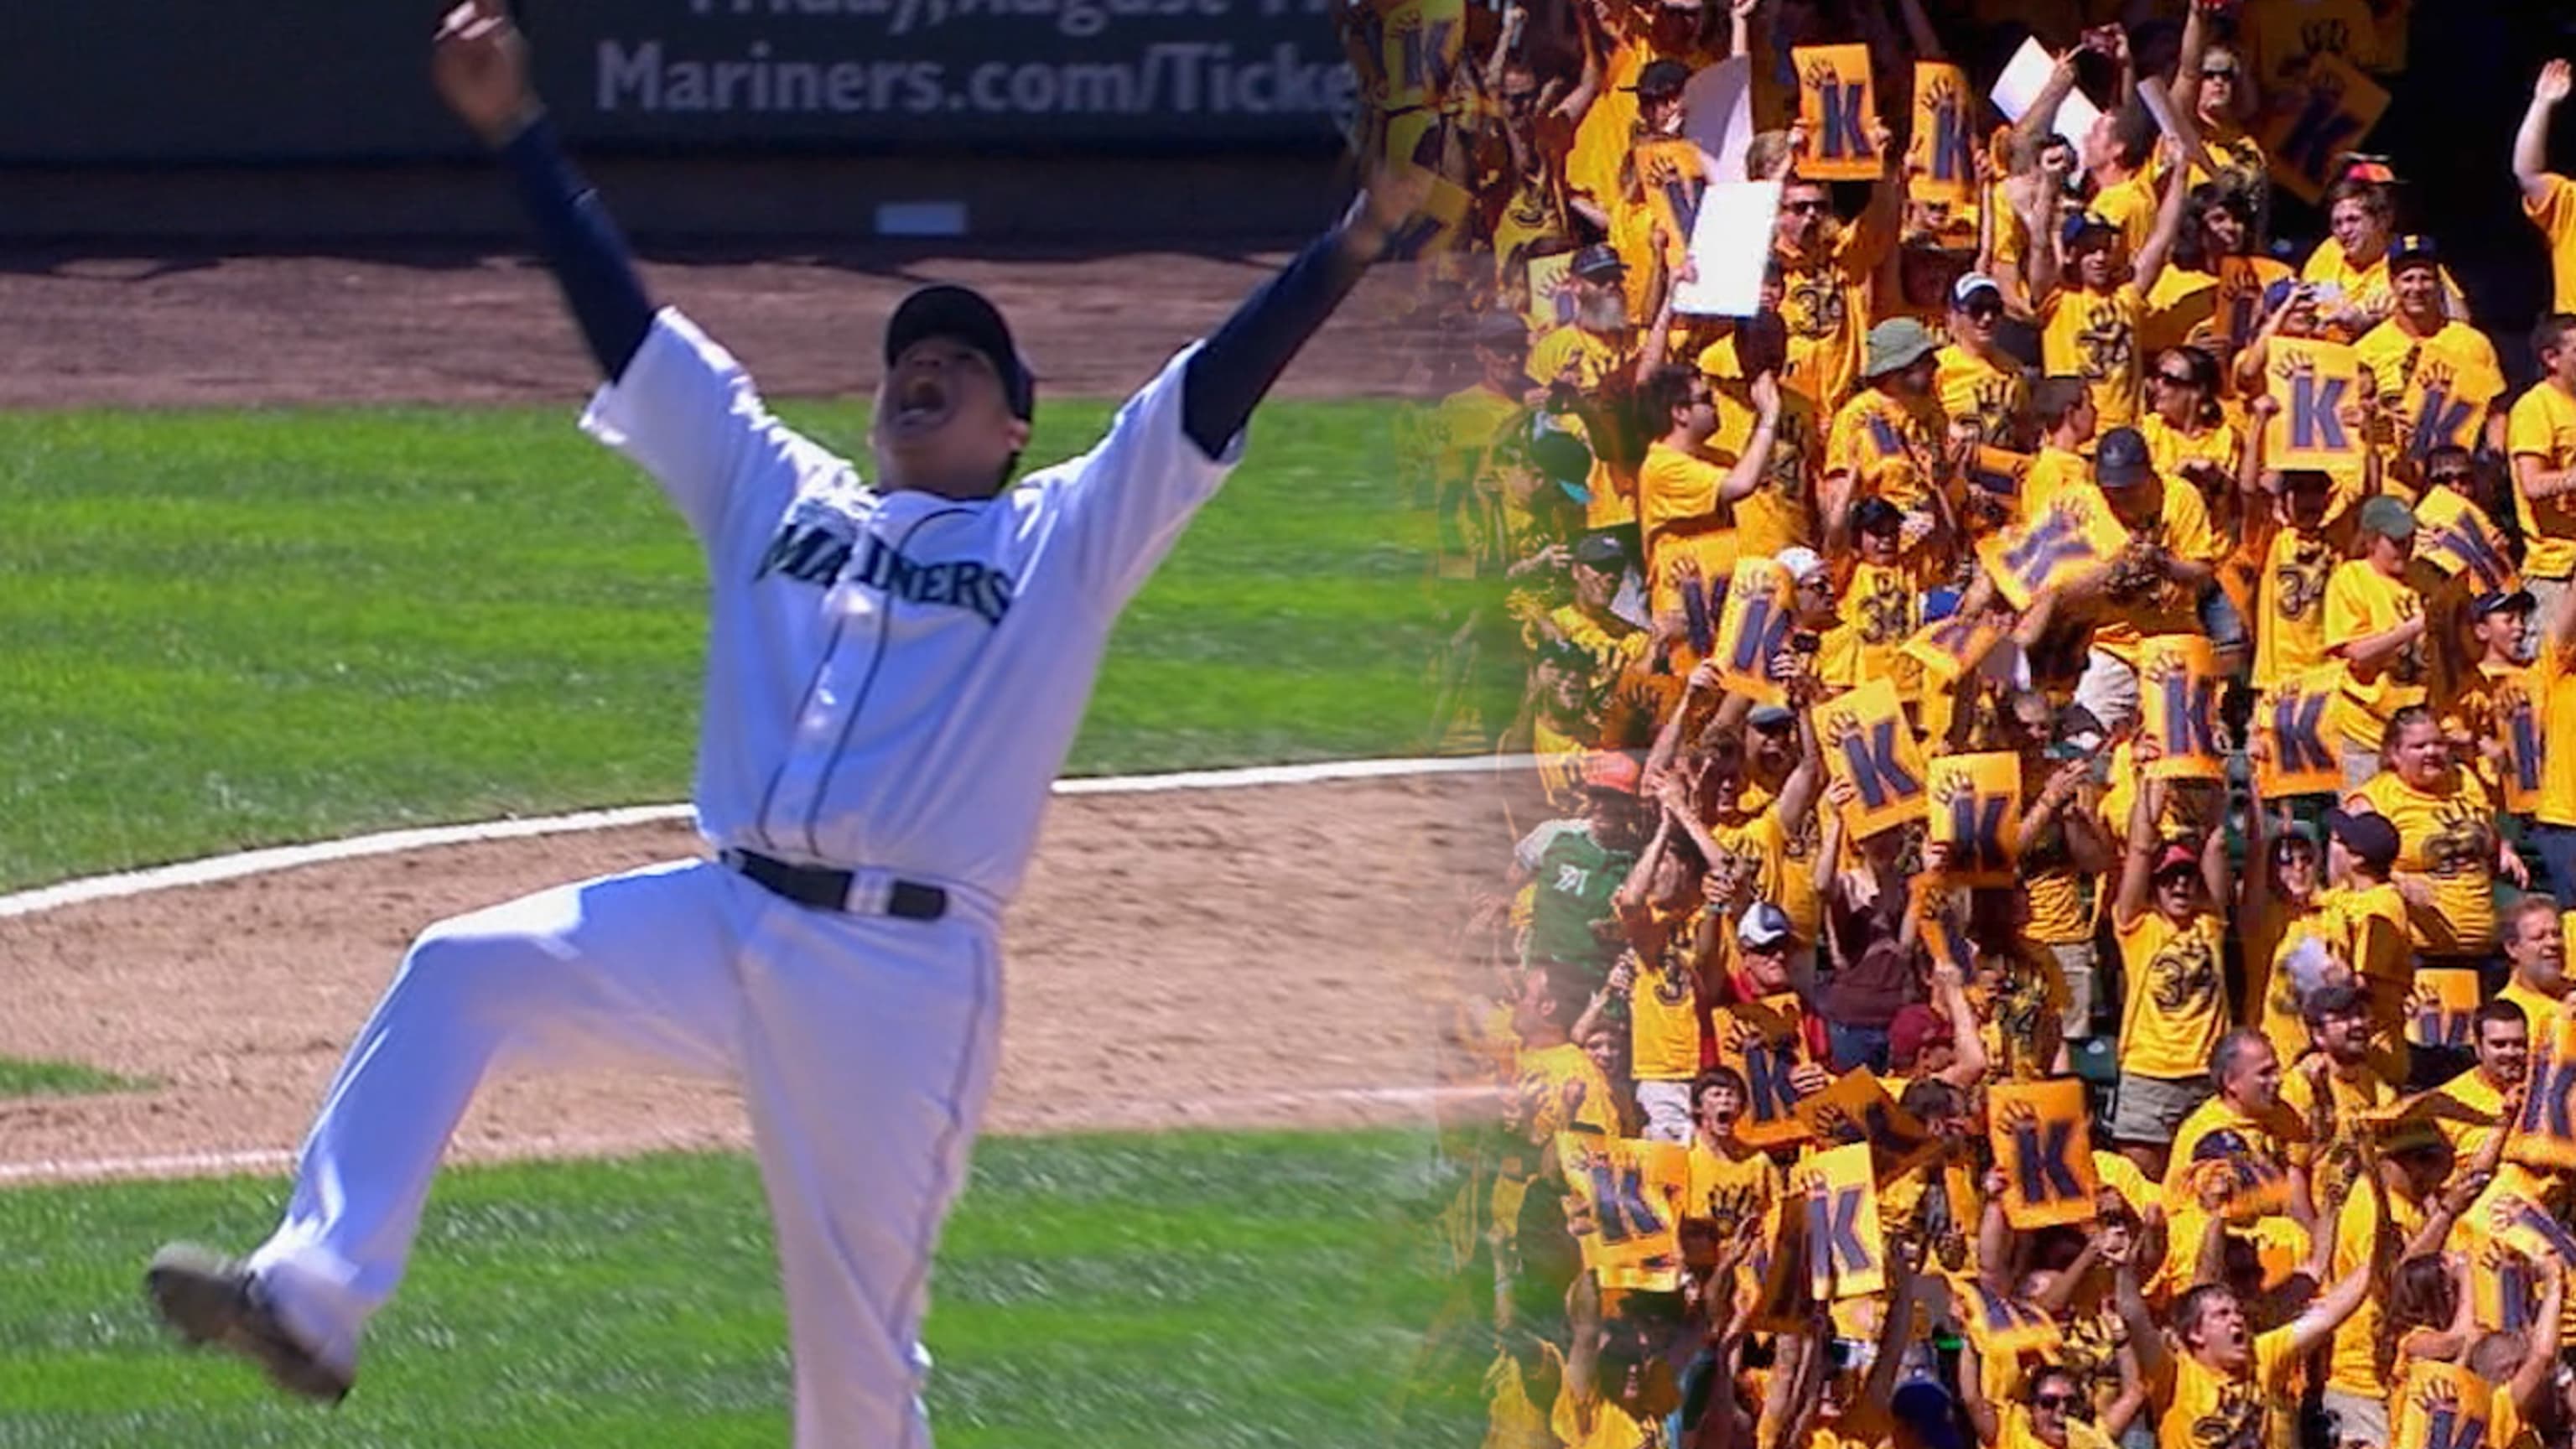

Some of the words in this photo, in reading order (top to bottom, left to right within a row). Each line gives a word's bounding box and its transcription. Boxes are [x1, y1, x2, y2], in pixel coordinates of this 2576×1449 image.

[1822, 82, 1873, 158] K
[2277, 91, 2365, 184] K
[2291, 376, 2349, 449] K
[2407, 389, 2474, 461] K
[2001, 513, 2093, 589] K
[1734, 598, 1793, 676] K
[2167, 673, 2215, 755] K
[2276, 693, 2336, 773] K
[1844, 722, 1919, 808] K
[1954, 796, 2007, 874] K
[1746, 1041, 1798, 1122] K
[2019, 1120, 2081, 1204] K
[1592, 1166, 1665, 1241] K
[1807, 1187, 1871, 1278] K
